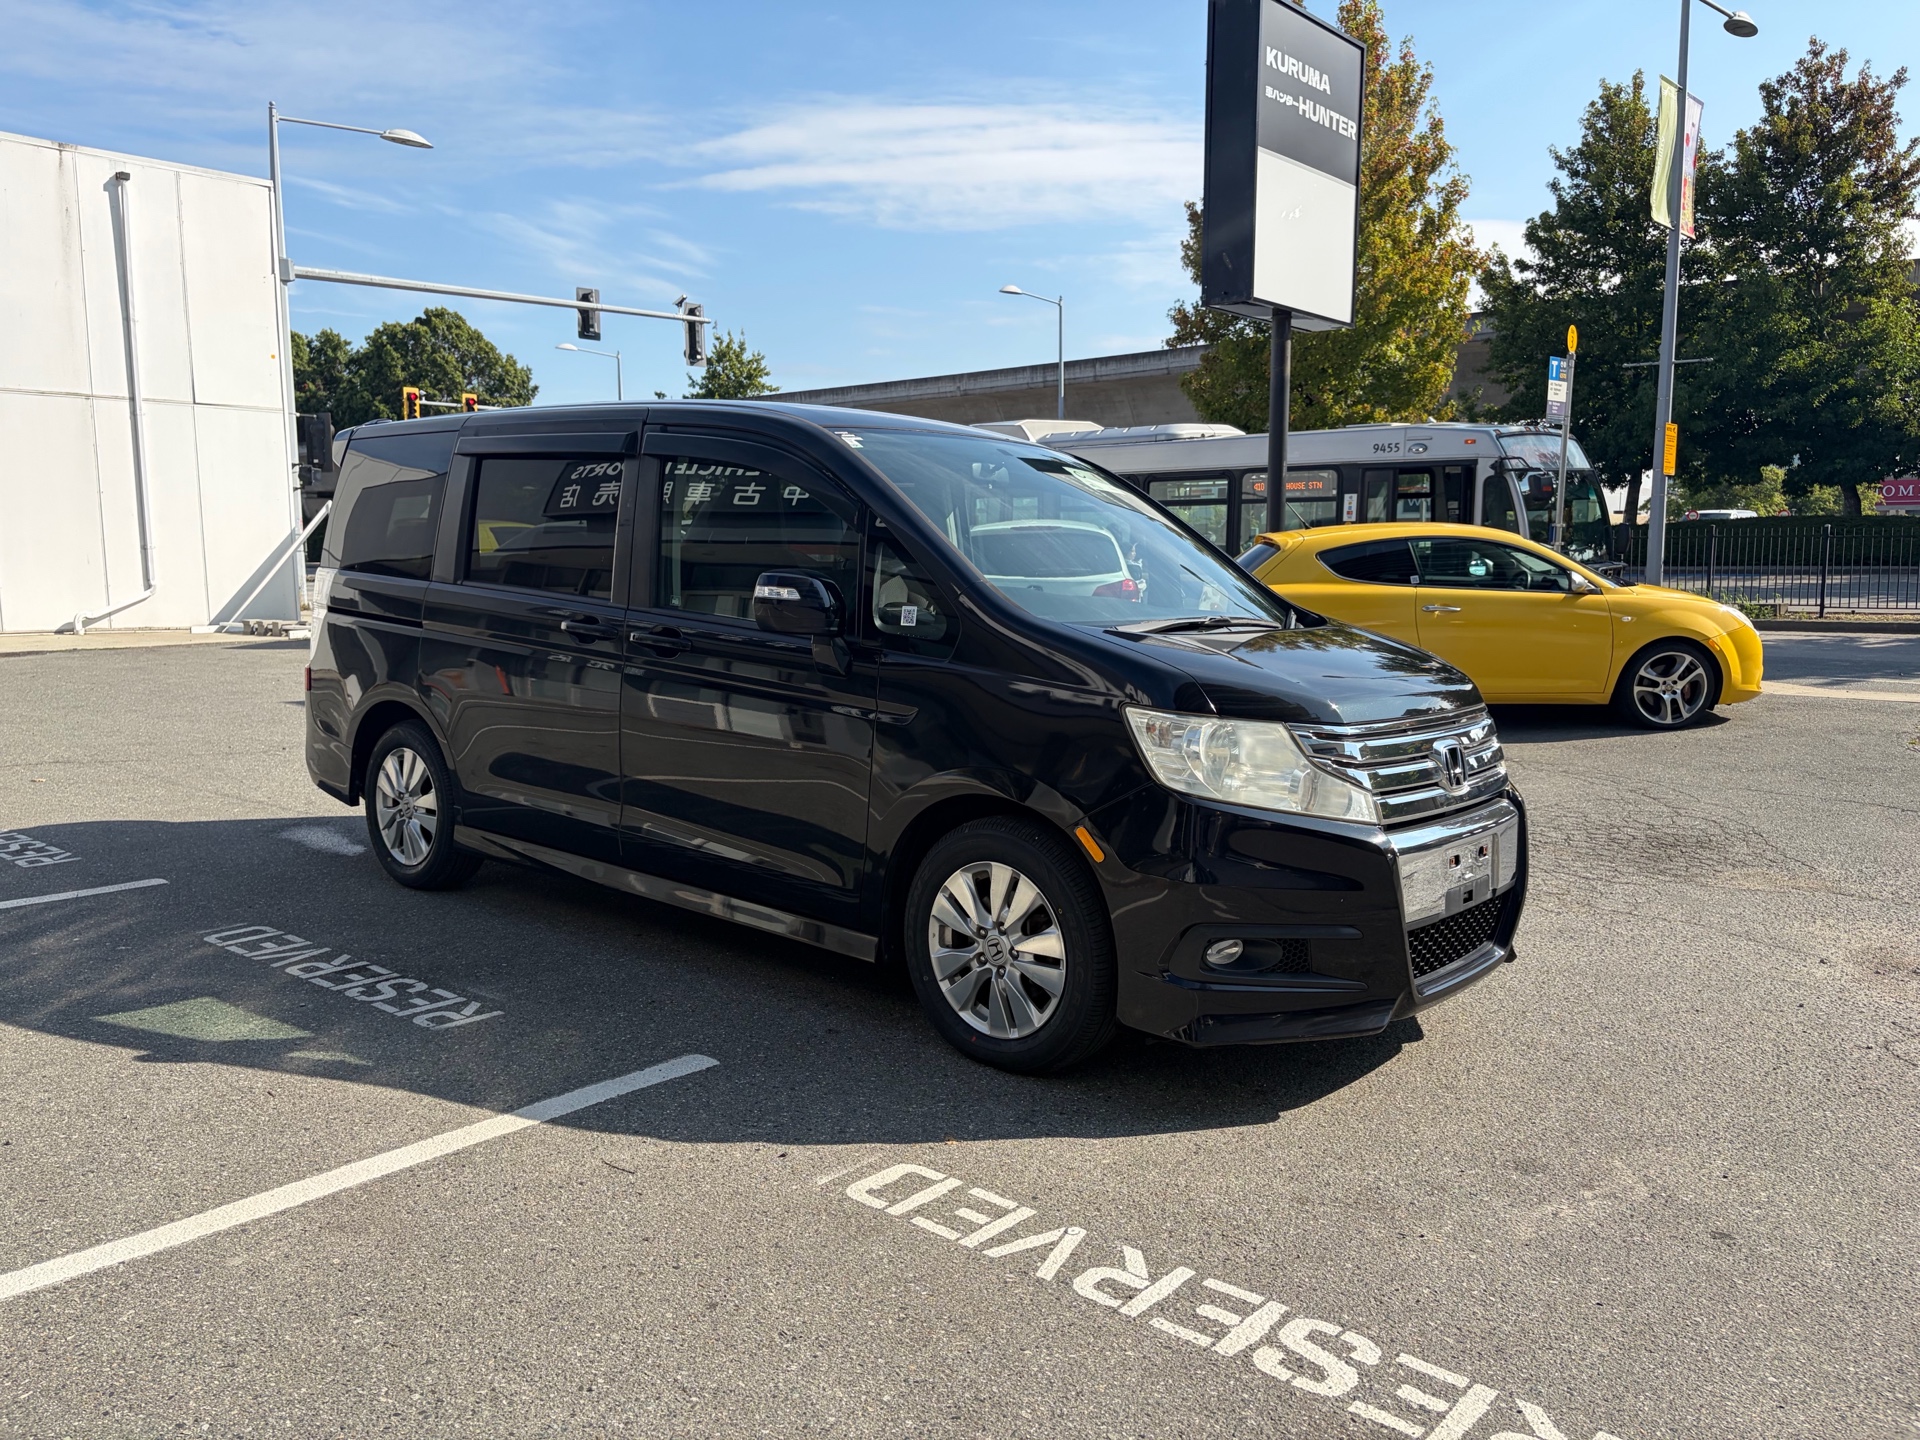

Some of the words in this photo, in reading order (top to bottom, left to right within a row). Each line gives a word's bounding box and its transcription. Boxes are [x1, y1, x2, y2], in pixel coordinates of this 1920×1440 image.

[1266, 46, 1331, 95] KURUMA
[1299, 95, 1357, 141] HUNTER
[1373, 443, 1400, 454] 9455
[1253, 482, 1265, 491] 410
[1308, 481, 1323, 489] STN
[203, 925, 505, 1030] RESERVED
